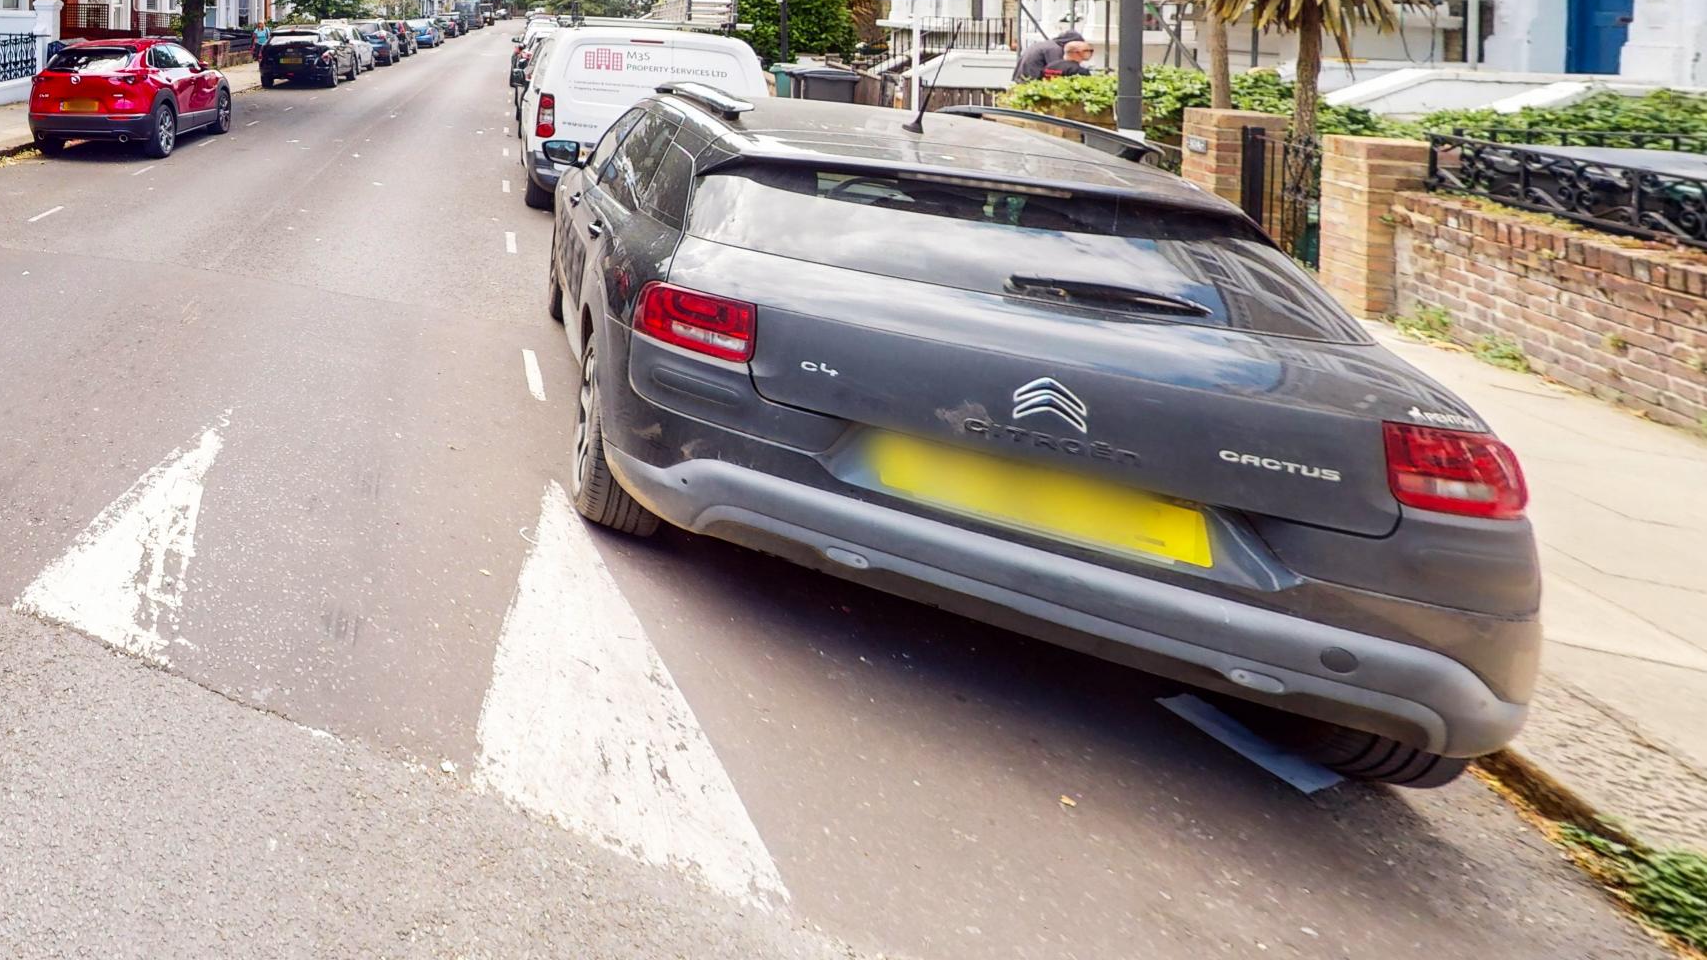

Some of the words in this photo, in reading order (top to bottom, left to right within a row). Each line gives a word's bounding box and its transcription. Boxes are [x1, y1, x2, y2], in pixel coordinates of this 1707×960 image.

[626, 63, 668, 73] PROPERTY
[670, 66, 710, 77] SERVICES
[711, 70, 728, 79] LTD
[800, 361, 839, 377] C4
[1218, 449, 1342, 482] CACTUS
